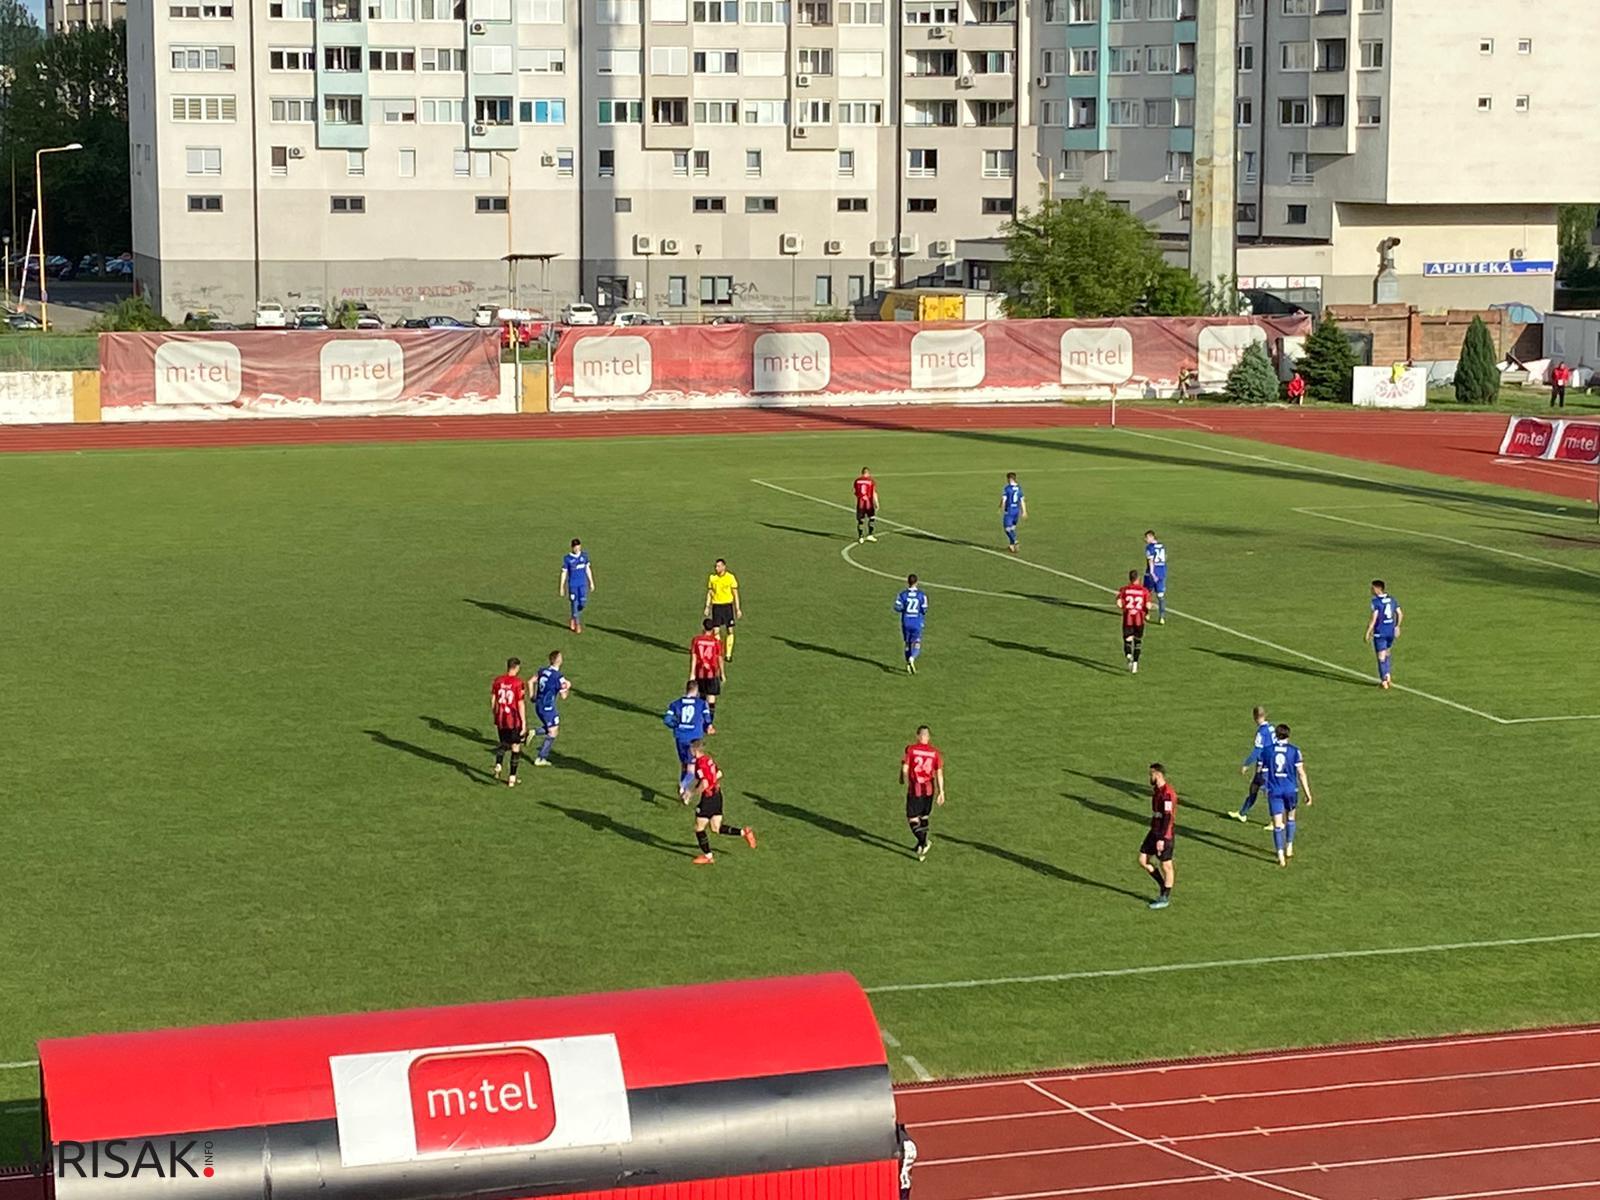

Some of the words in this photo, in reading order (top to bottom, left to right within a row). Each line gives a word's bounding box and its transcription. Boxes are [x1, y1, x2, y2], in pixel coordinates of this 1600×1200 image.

[1429, 261, 1513, 274] APOTEKA
[583, 354, 642, 376] m:tel
[763, 350, 821, 372] m:tel
[920, 346, 976, 369] m:tel
[1069, 343, 1124, 366] m:tel
[165, 360, 231, 383] m:tel
[331, 358, 393, 381] m:tel
[1514, 431, 1549, 447] m:tel
[1563, 435, 1598, 452] m:tel
[906, 597, 920, 613] 22
[1125, 595, 1143, 610] 22
[914, 756, 933, 774] 24
[426, 1070, 538, 1118] m:tel
